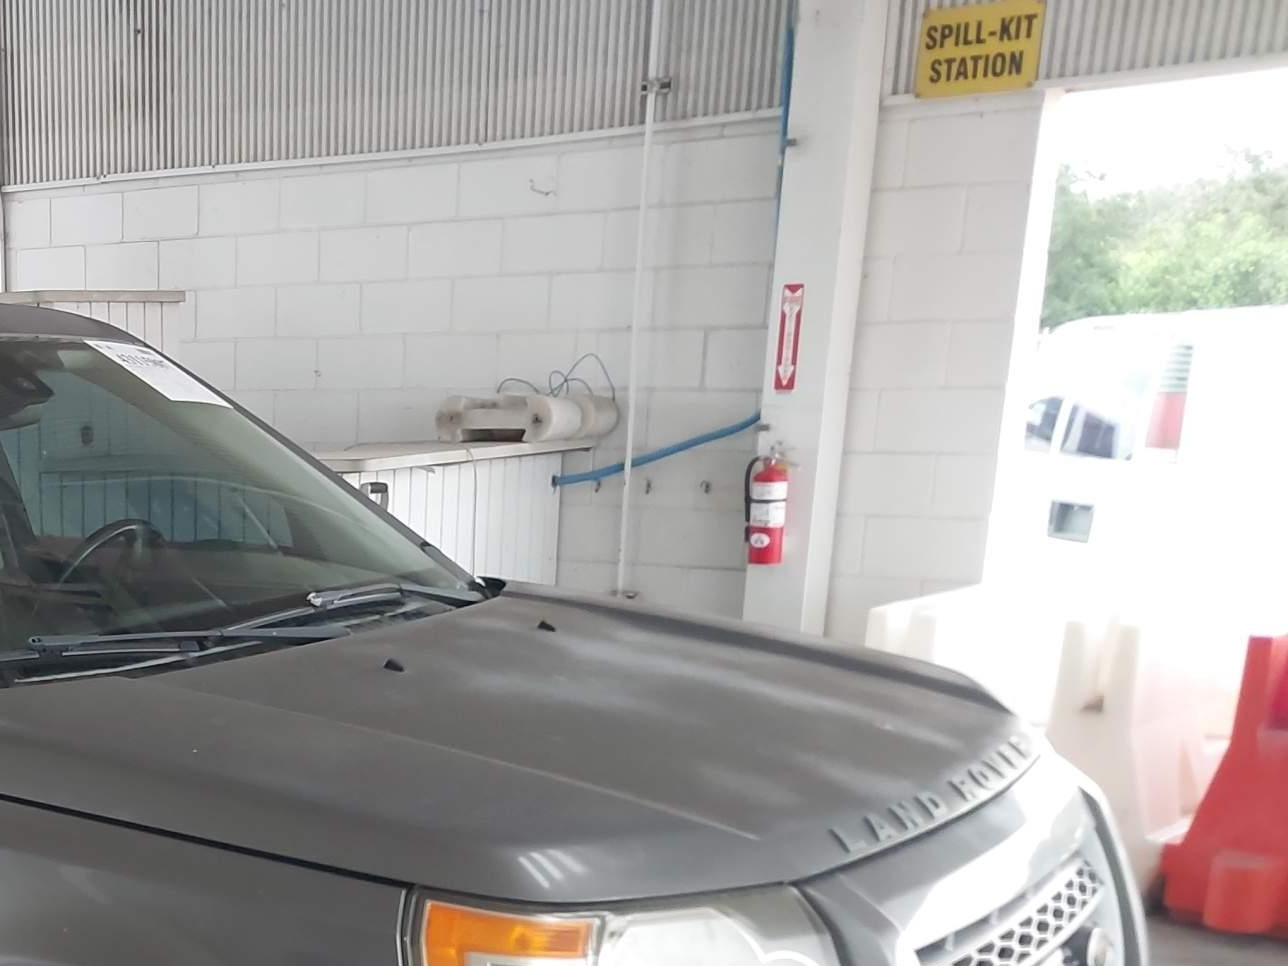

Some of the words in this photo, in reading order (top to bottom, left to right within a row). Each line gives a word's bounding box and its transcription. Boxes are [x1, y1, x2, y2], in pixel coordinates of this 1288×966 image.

[925, 13, 1038, 50] SPILL-KIT
[929, 50, 1024, 83] STATION
[827, 791, 945, 854] LAND
